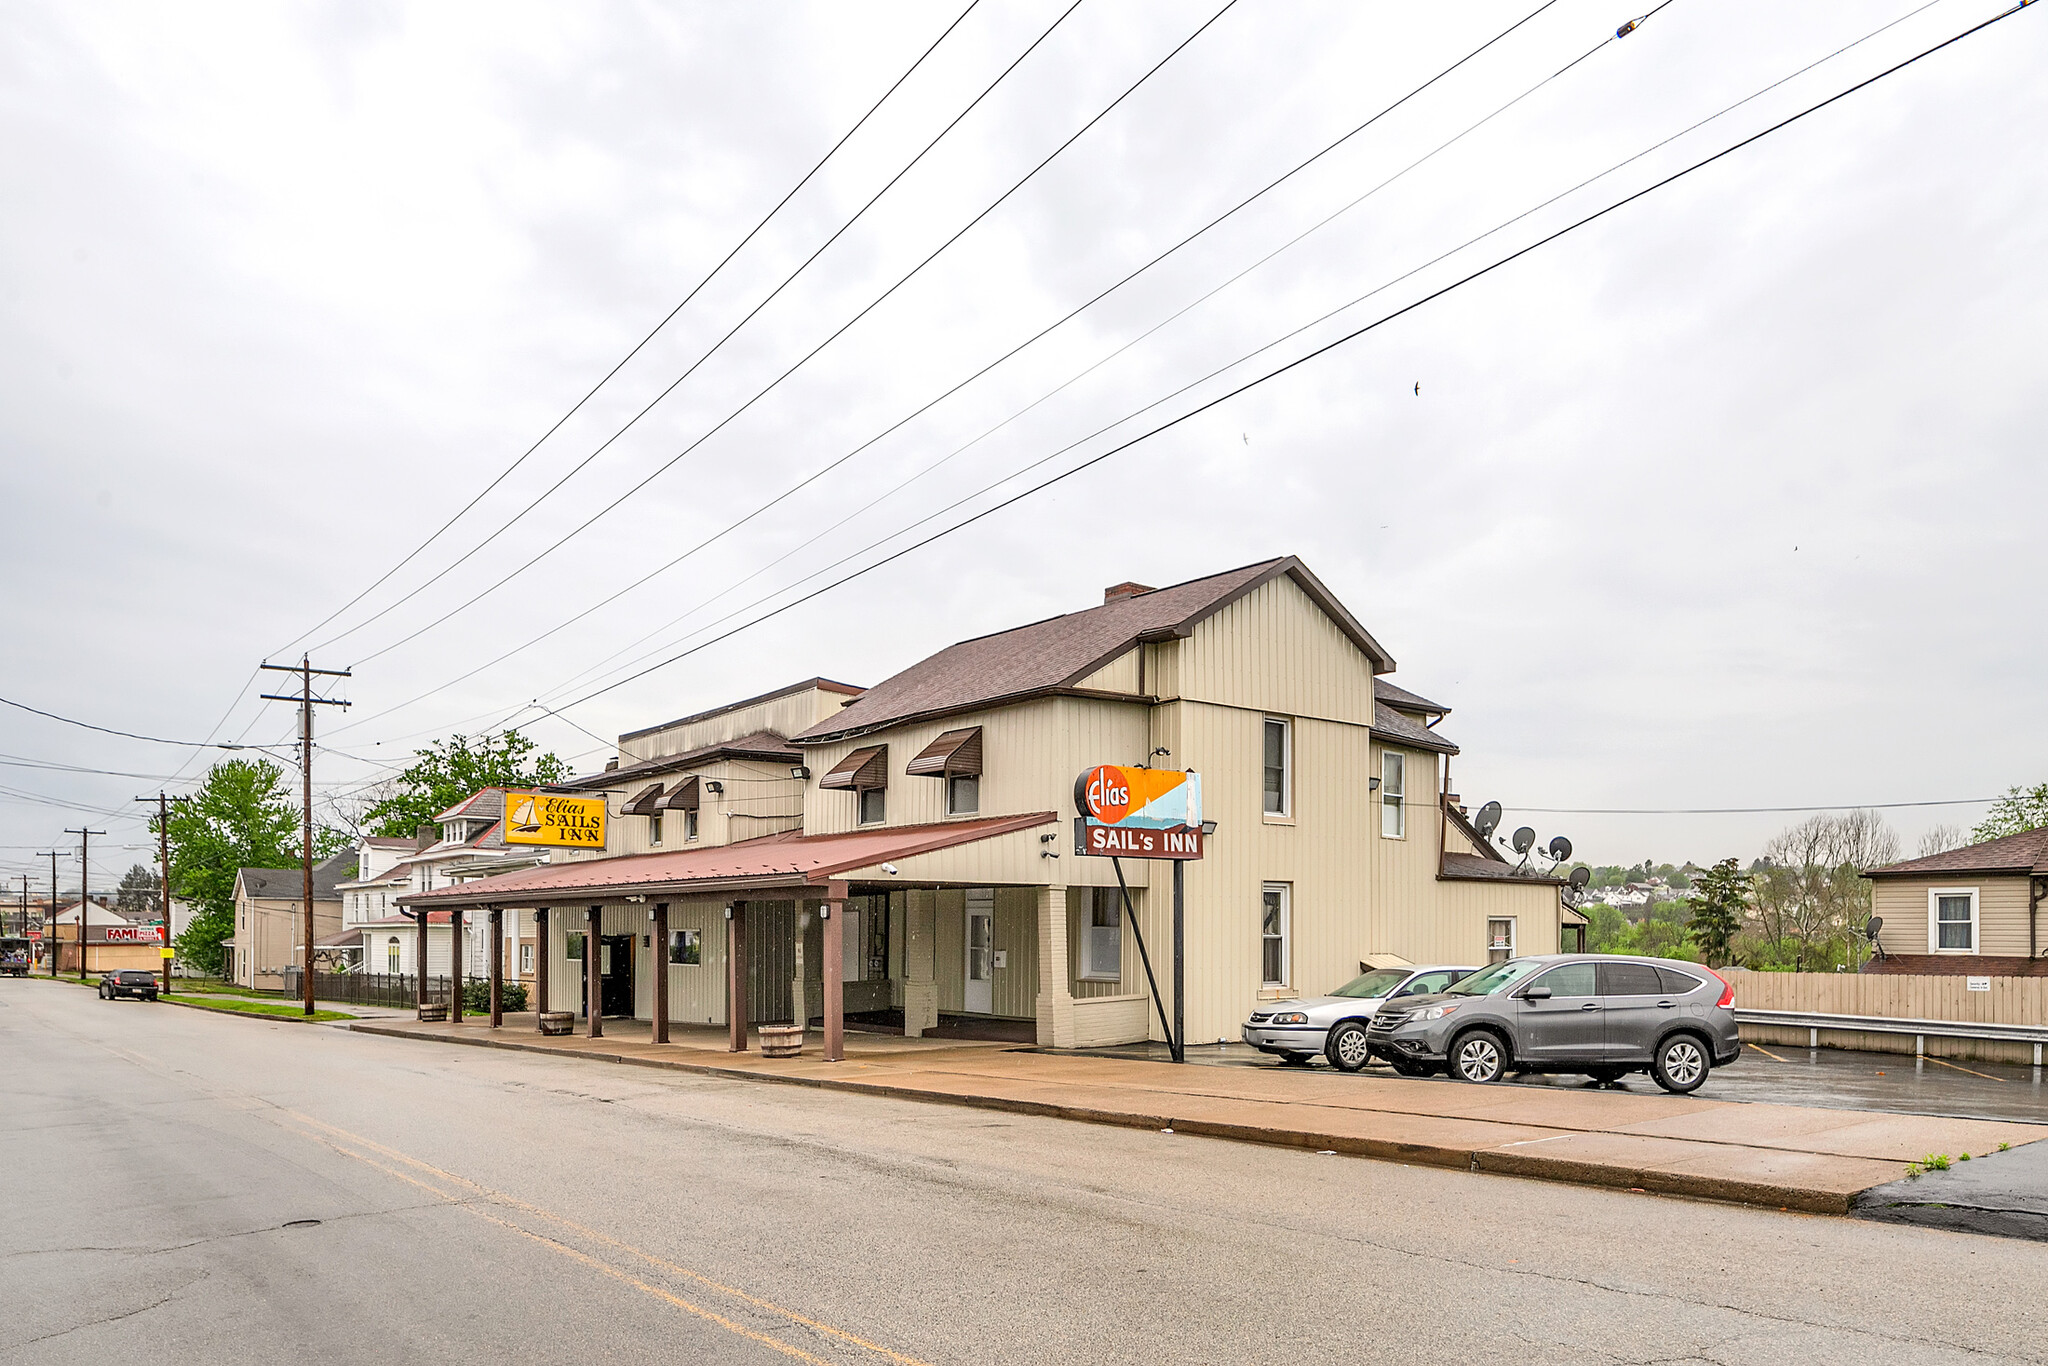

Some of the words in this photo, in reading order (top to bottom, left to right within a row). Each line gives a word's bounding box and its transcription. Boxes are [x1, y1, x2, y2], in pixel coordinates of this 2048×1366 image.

[1088, 767, 1129, 814] Elias
[545, 797, 585, 815] Elias
[545, 814, 601, 829] SAILS
[559, 828, 599, 842] INN
[1093, 828, 1154, 851] SAIL's
[1163, 832, 1198, 853] INN
